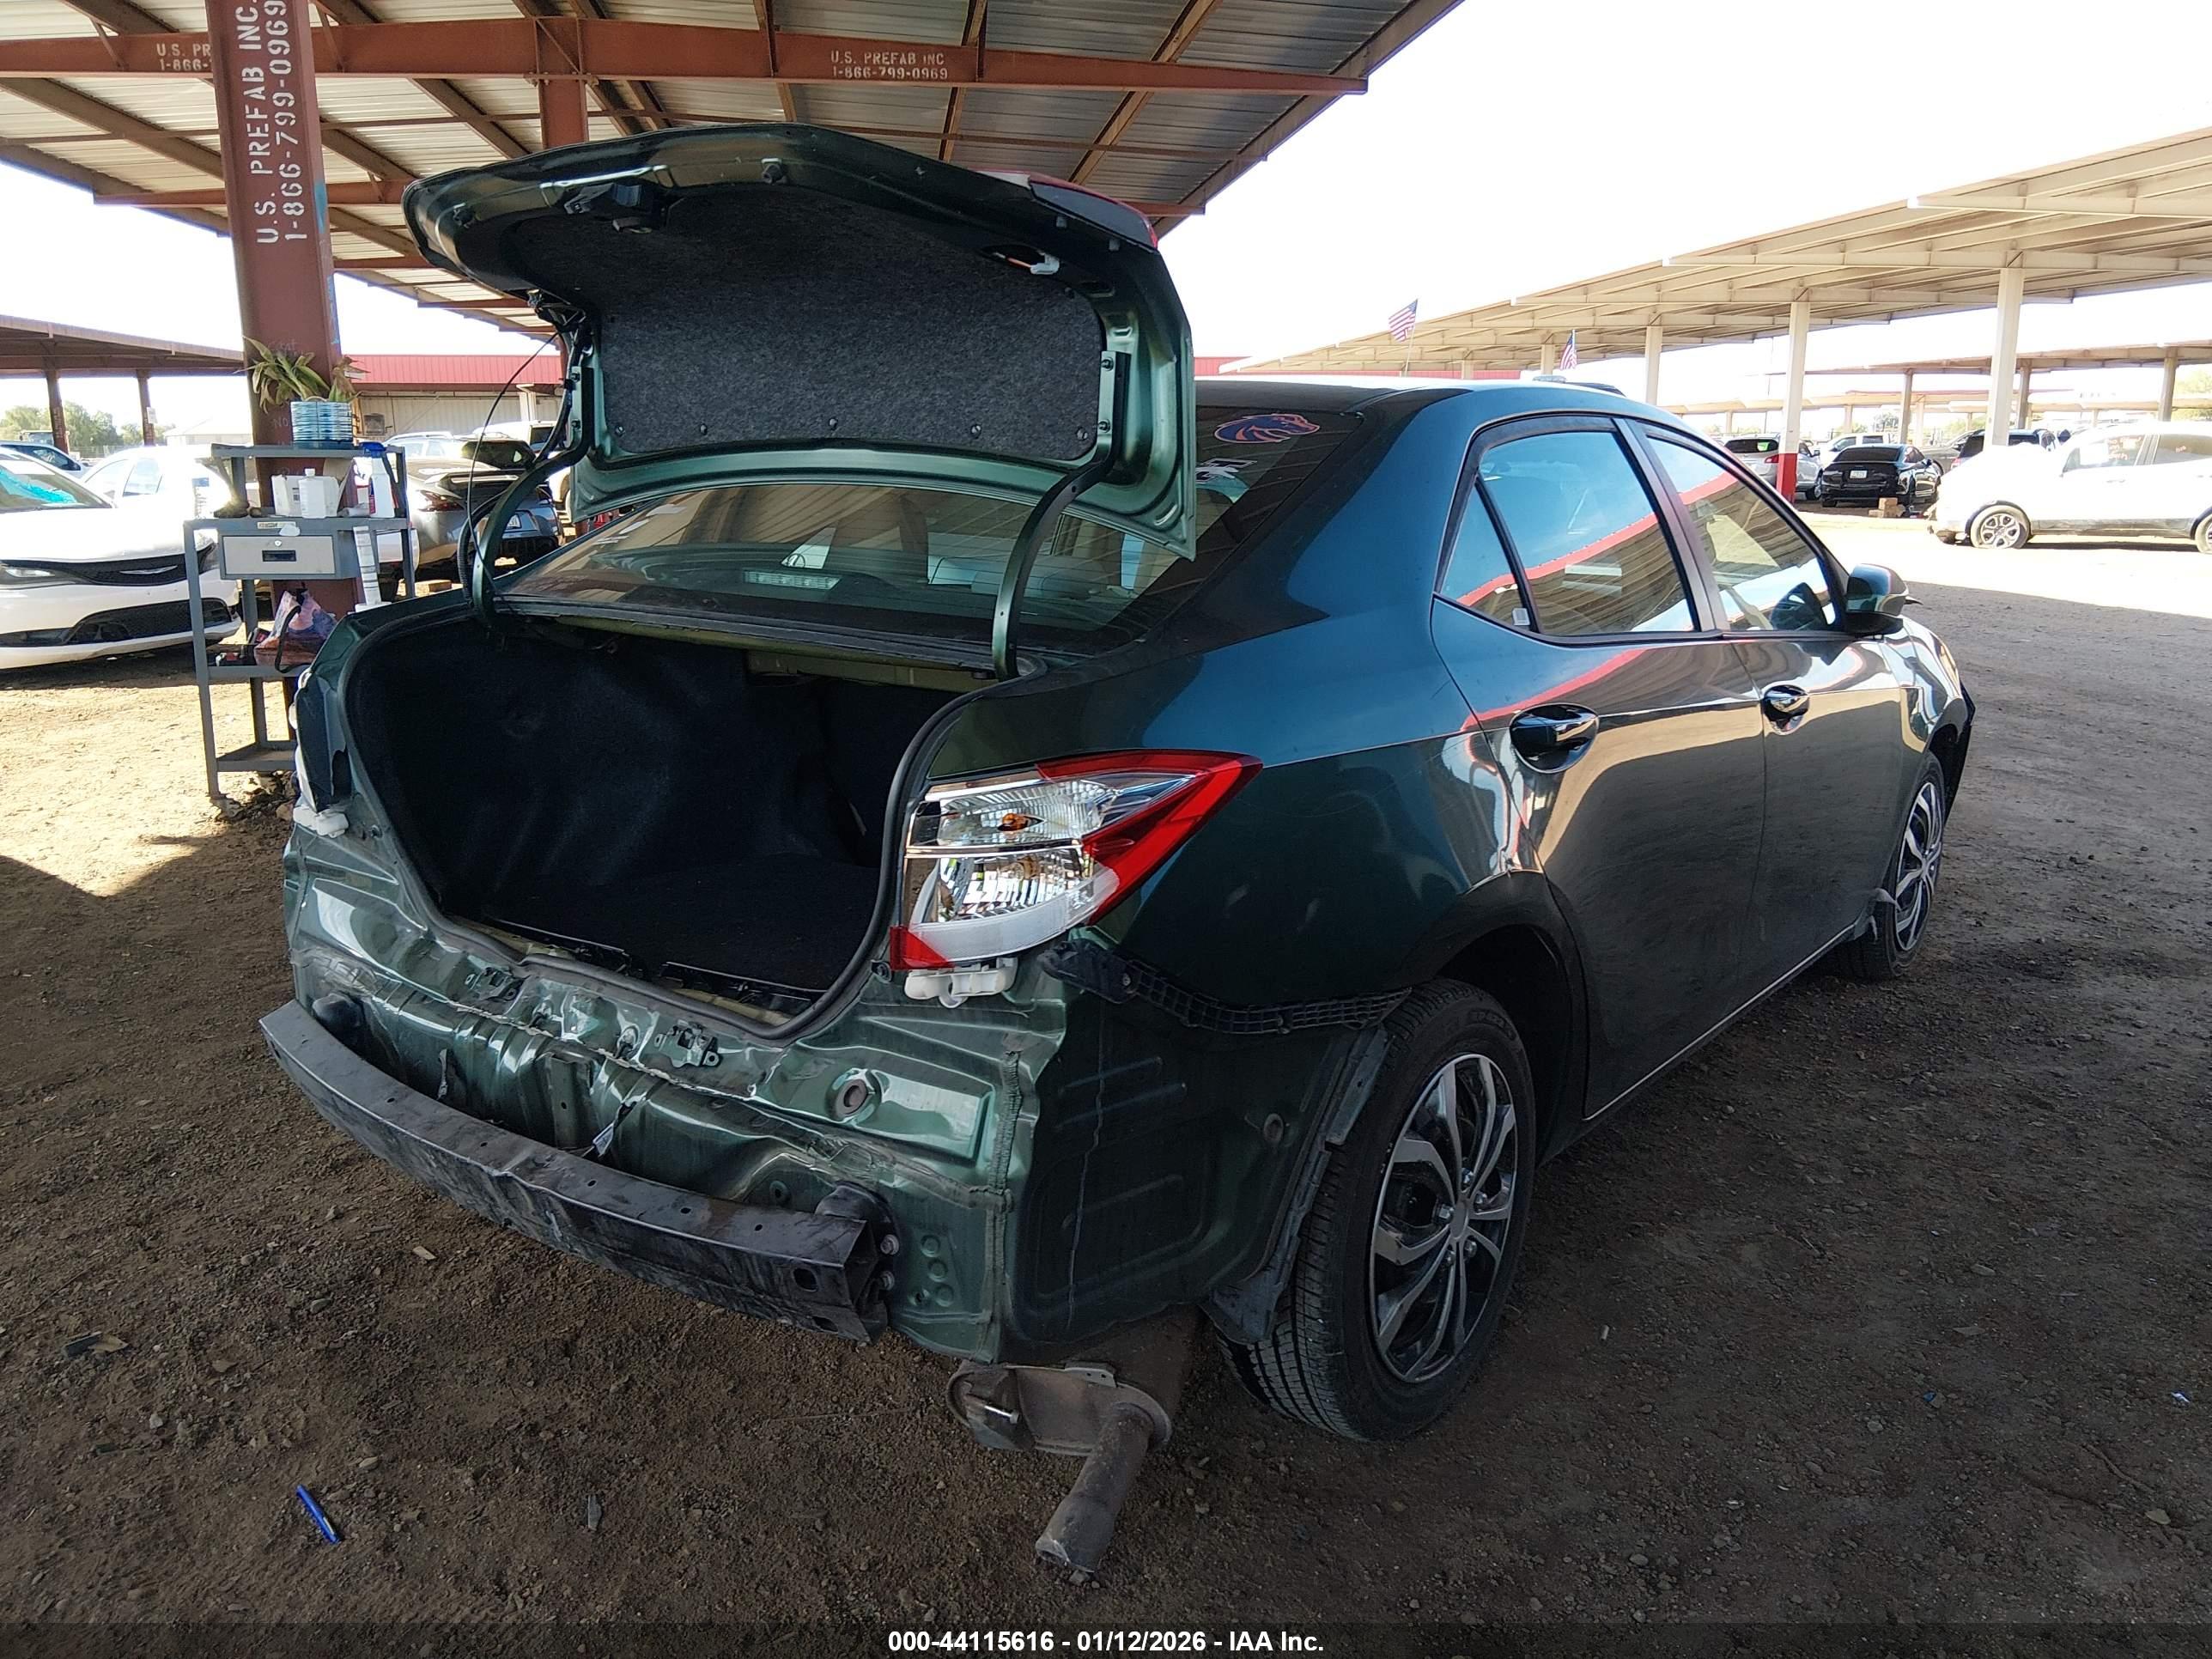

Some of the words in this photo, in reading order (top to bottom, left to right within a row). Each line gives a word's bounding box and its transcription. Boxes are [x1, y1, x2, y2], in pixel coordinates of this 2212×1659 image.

[156, 43, 186, 57] U.S.
[830, 51, 857, 64] U.S.
[864, 52, 916, 65] PREFAB
[832, 65, 948, 80] 1-866-799-0969
[241, 67, 274, 174] PREFAB
[263, 0, 307, 240] 1-866-799-0969
[254, 192, 279, 243] U.S.
